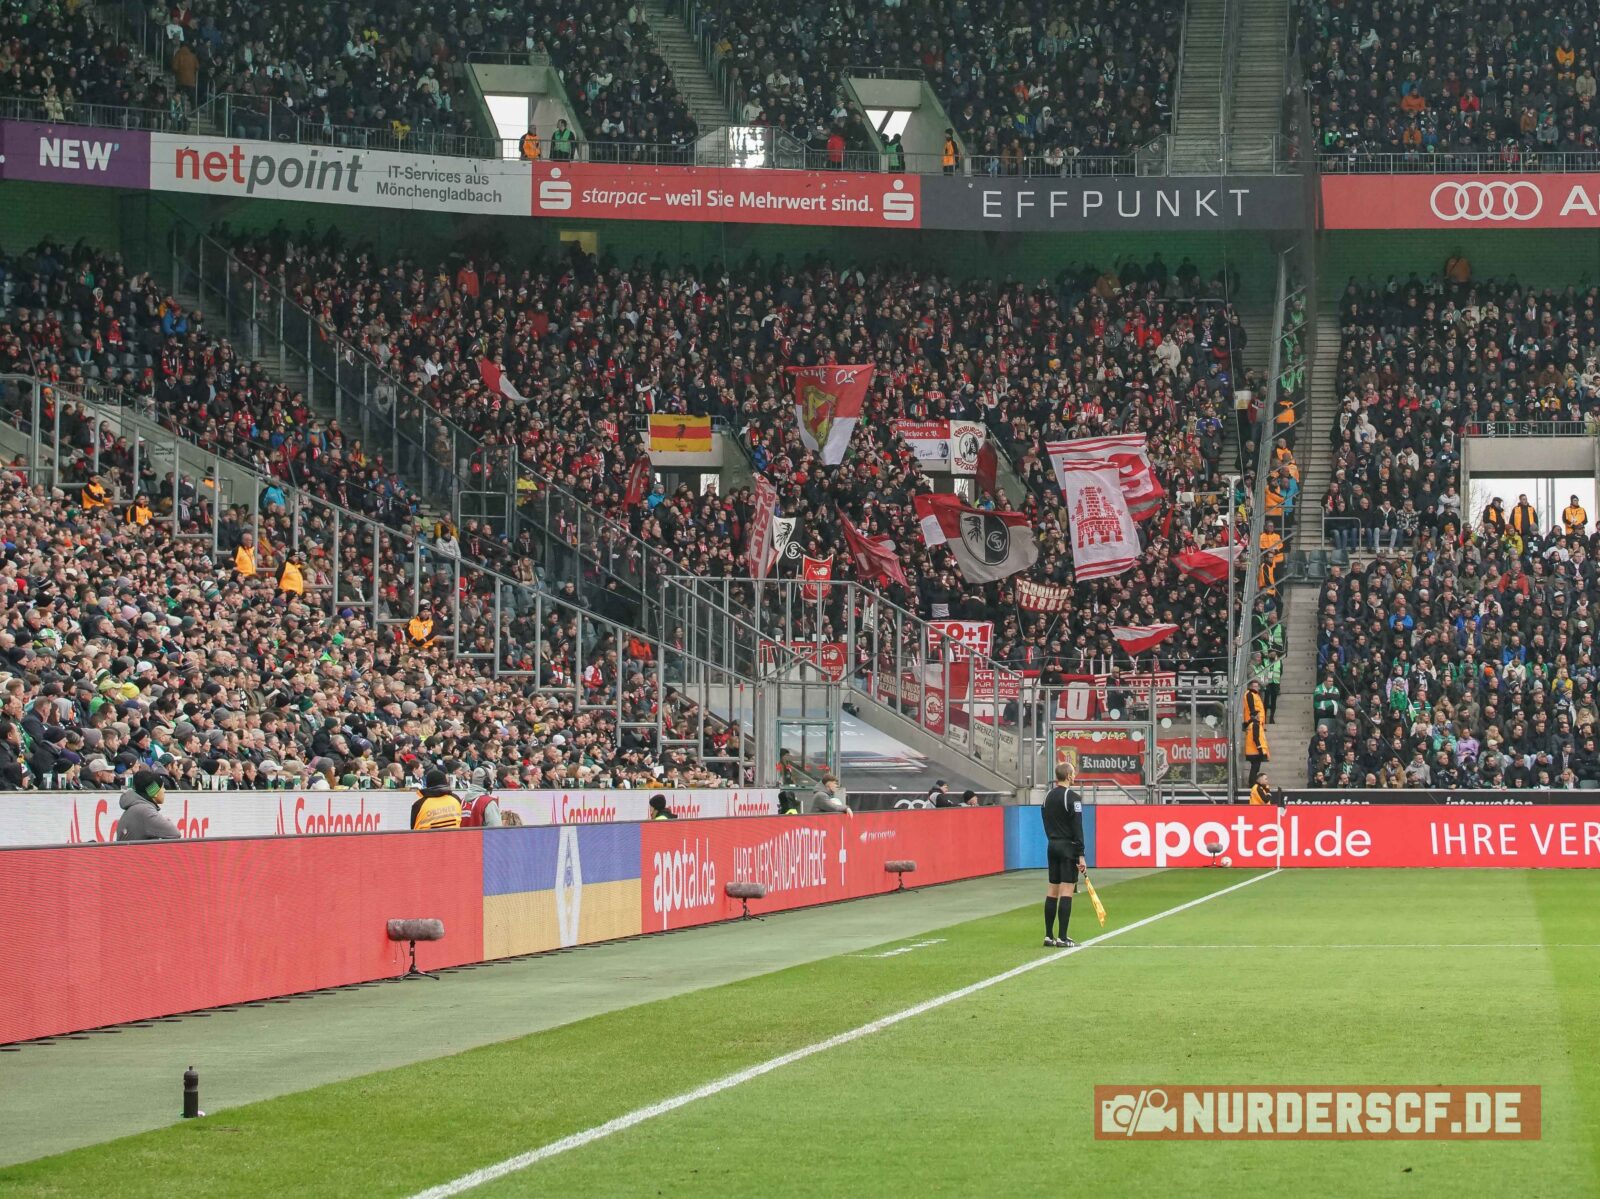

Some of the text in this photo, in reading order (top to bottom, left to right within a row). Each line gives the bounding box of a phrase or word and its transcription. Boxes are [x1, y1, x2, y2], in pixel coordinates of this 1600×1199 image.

[175, 144, 362, 194] netpoint
[388, 165, 490, 185] IT-Services aus
[376, 181, 503, 203] Mönchengladbach
[582, 187, 648, 208] starpac
[666, 188, 701, 207] weil
[706, 190, 735, 208] Sie
[738, 191, 828, 211] Mehrwert
[831, 193, 874, 213] sind.
[982, 188, 1250, 218] EFFPUNKT
[1082, 756, 1136, 771] Knaddly's
[1120, 814, 1372, 868] apotal.de
[1429, 822, 1519, 856] IHRE
[653, 836, 716, 930] apotal.de
